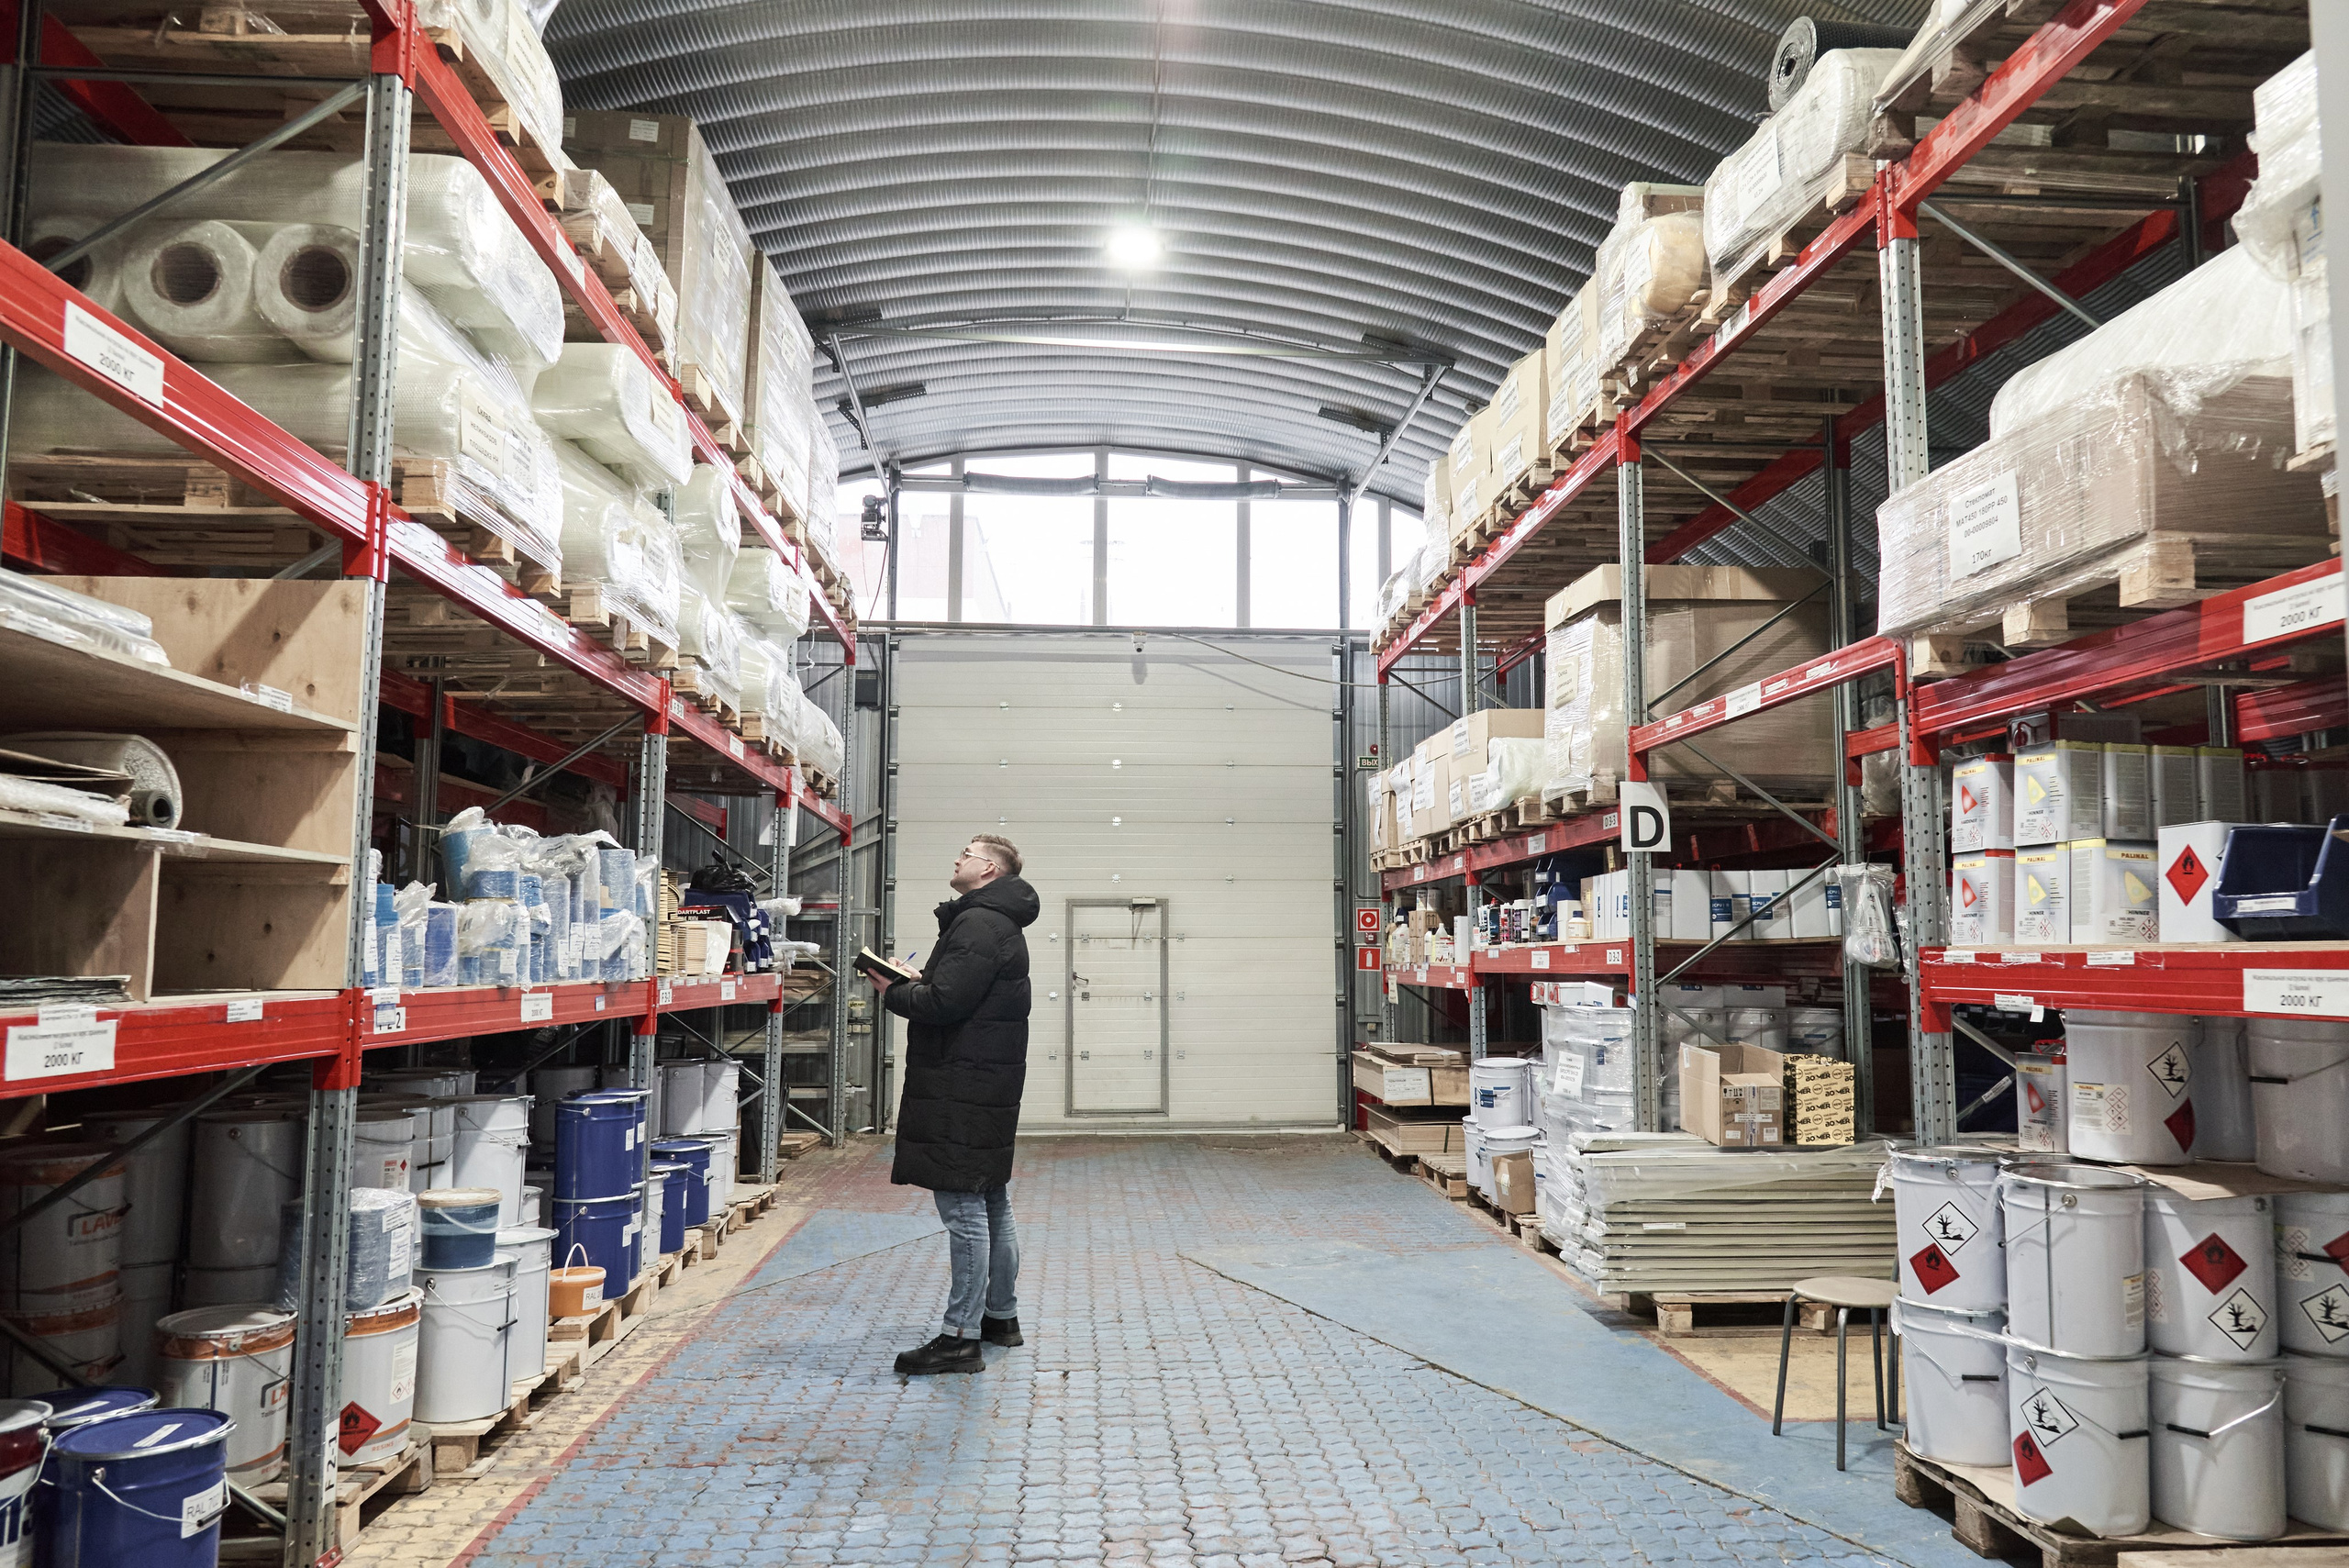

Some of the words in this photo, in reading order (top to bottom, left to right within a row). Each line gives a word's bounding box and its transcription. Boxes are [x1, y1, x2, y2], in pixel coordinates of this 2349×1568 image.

[99, 352, 121, 375] 2000
[123, 368, 135, 382] КГ
[477, 405, 492, 423] Склад
[1965, 487, 1996, 508] Стекломат
[1997, 495, 2009, 506] 450
[1972, 549, 1992, 564] 170кг
[2280, 610, 2306, 628] 2000
[2309, 606, 2322, 620] КГ
[1630, 806, 1664, 848] D
[2280, 995, 2306, 1006] 2000
[2309, 995, 2322, 1007] КГ
[44, 1053, 69, 1068] 2000
[72, 1051, 84, 1065] КГ
[371, 1441, 395, 1451] RESINS
[324, 1479, 335, 1492] F
[186, 1502, 206, 1518] RAL
